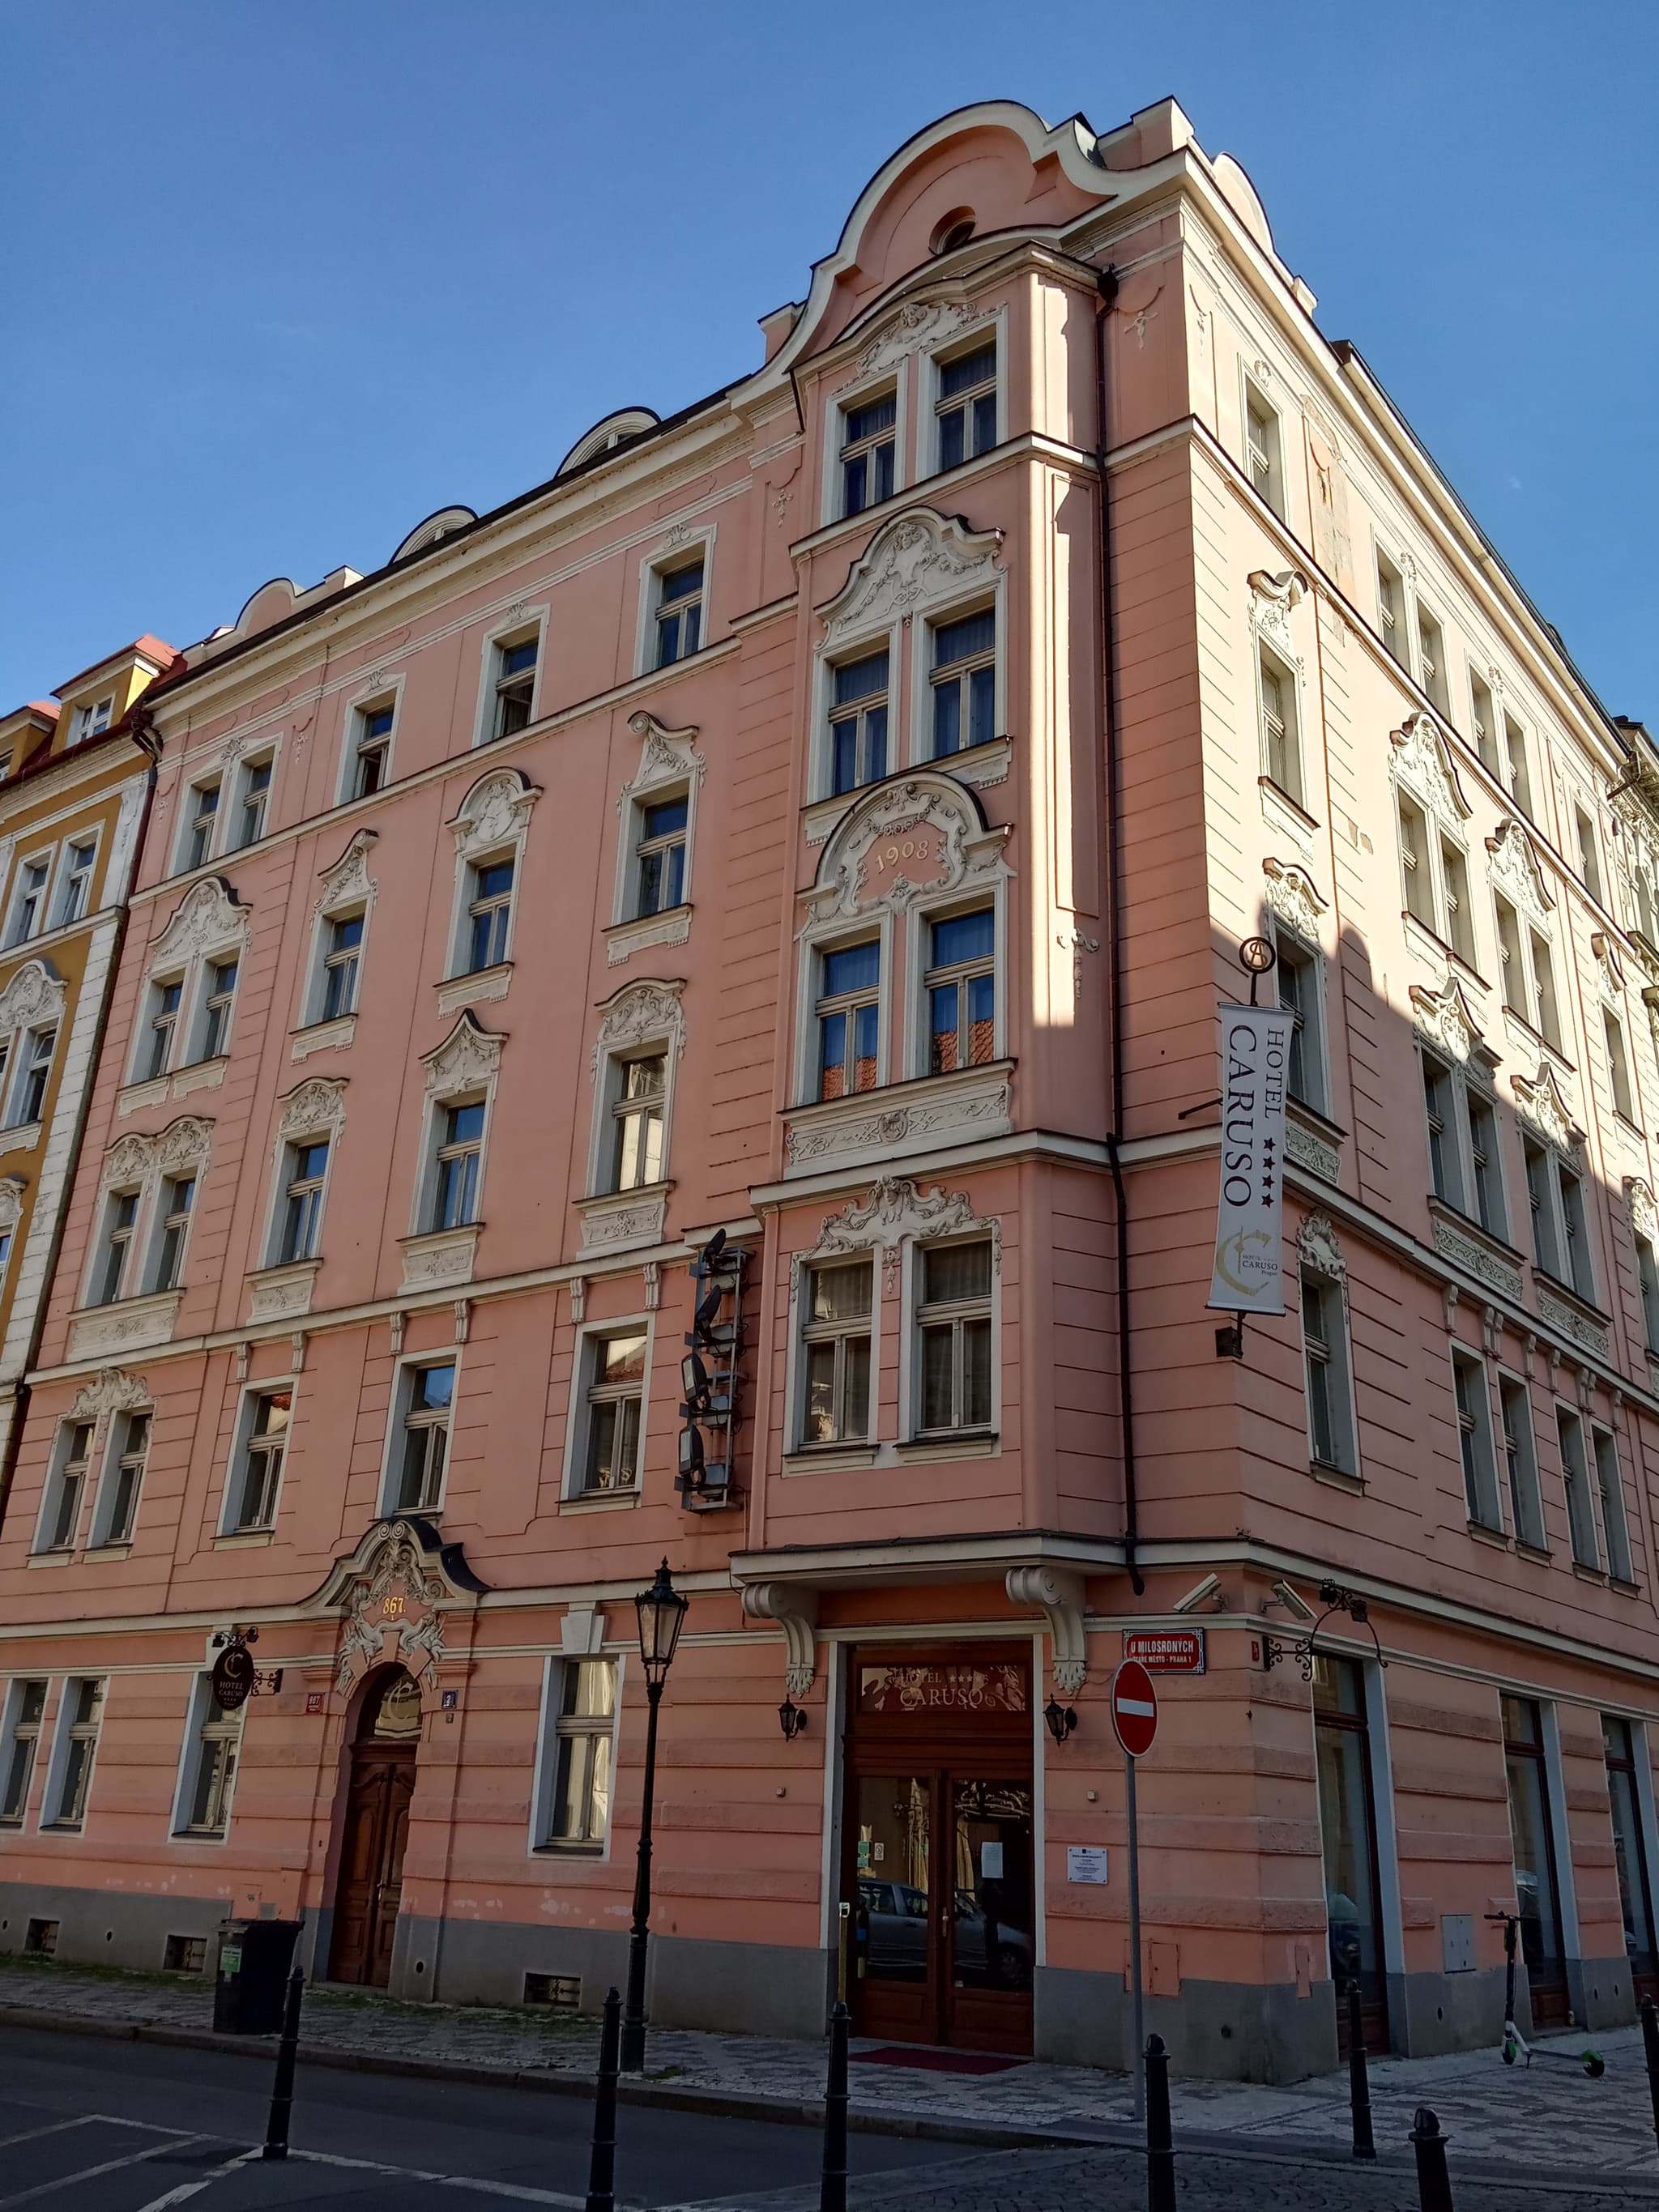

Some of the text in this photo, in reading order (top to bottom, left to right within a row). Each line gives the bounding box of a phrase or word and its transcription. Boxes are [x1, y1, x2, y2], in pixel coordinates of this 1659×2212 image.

[876, 841, 928, 874] 1908
[1265, 1028, 1285, 1119] HOTEL
[1223, 1025, 1257, 1206] CARUSO
[1242, 1260, 1278, 1271] CARUSO
[1131, 1638, 1194, 1653] U MILOSRDNÝCH
[220, 1681, 243, 1690] HOTEL
[900, 1672, 942, 1684] HOTEL
[899, 1687, 983, 1707] CARUSO
